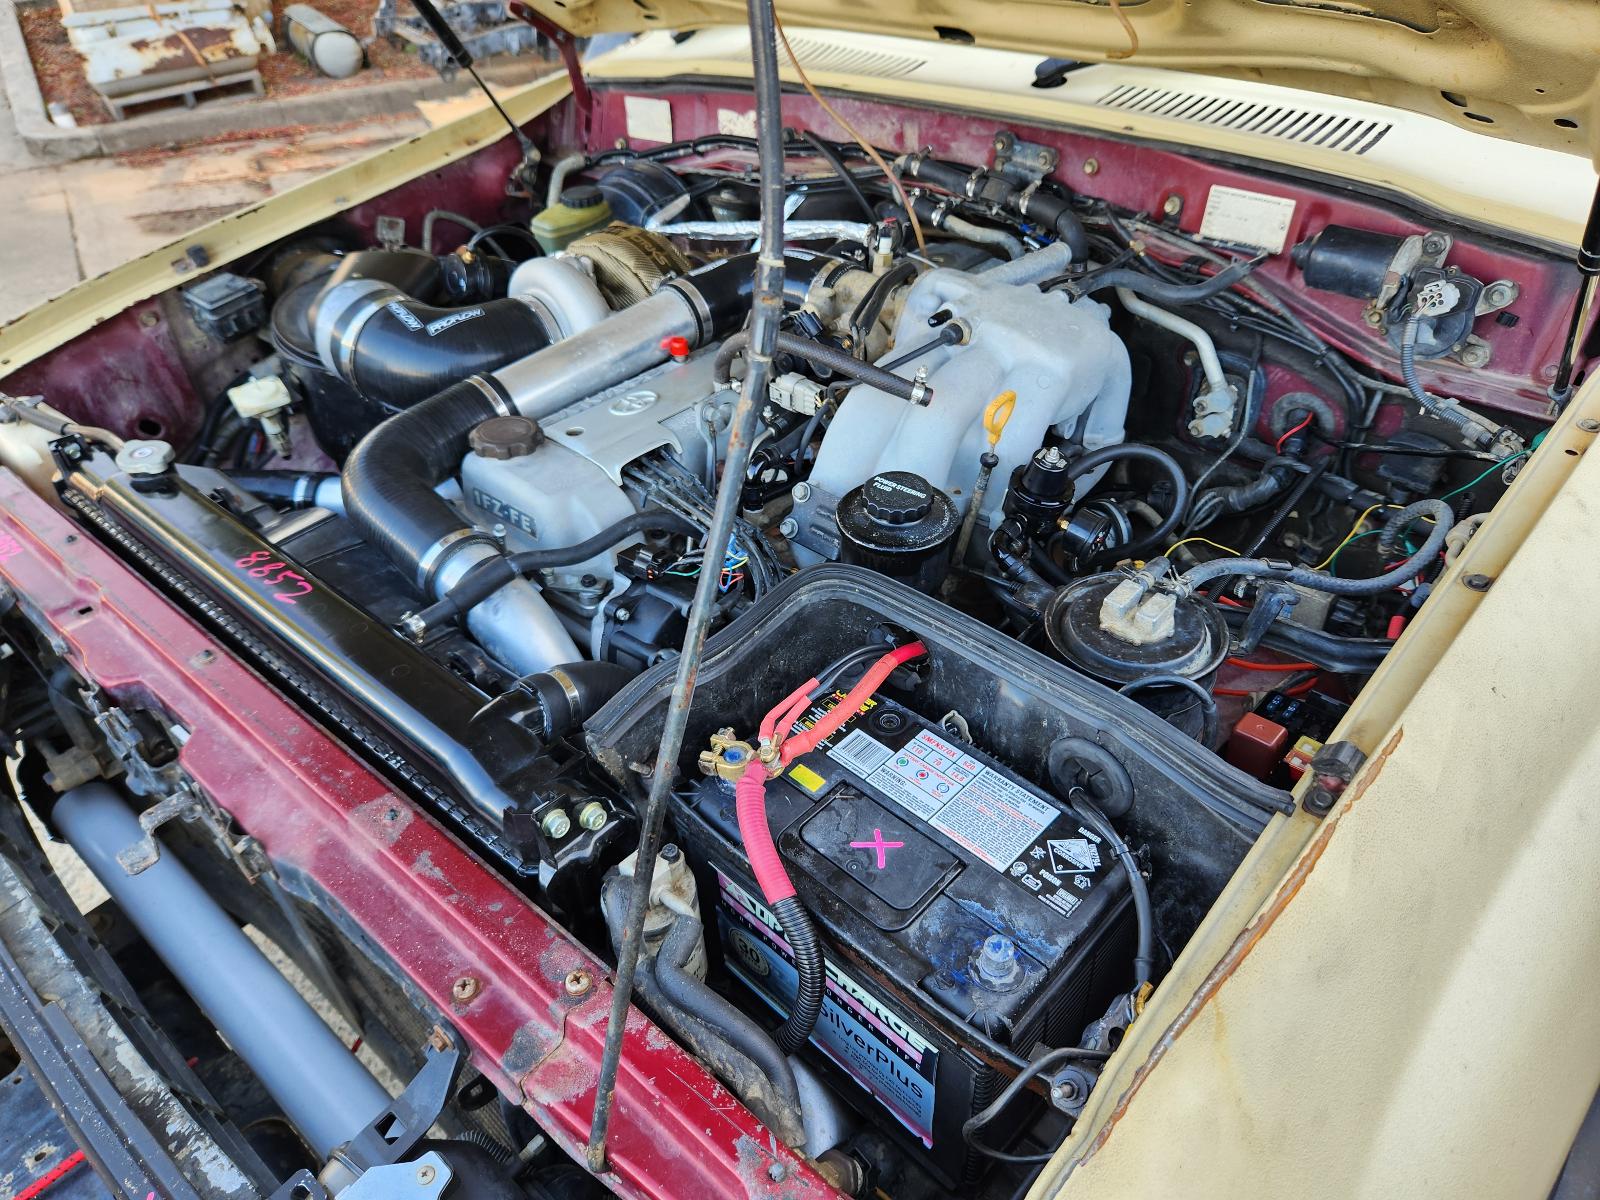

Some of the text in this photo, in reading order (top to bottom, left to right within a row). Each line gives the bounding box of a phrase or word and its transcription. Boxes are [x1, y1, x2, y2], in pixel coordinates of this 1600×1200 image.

[873, 482, 892, 492] FLUID
[874, 476, 927, 499] POWER STEERING
[932, 758, 942, 767] 70
[985, 770, 1016, 792] WARRANTY
[1015, 788, 1050, 812] STATEMENT
[1053, 847, 1085, 870] CORROSIVE
[1039, 868, 1062, 887] POISON
[825, 987, 874, 1032] ONGER
[819, 1002, 923, 1099] SilverPlus
